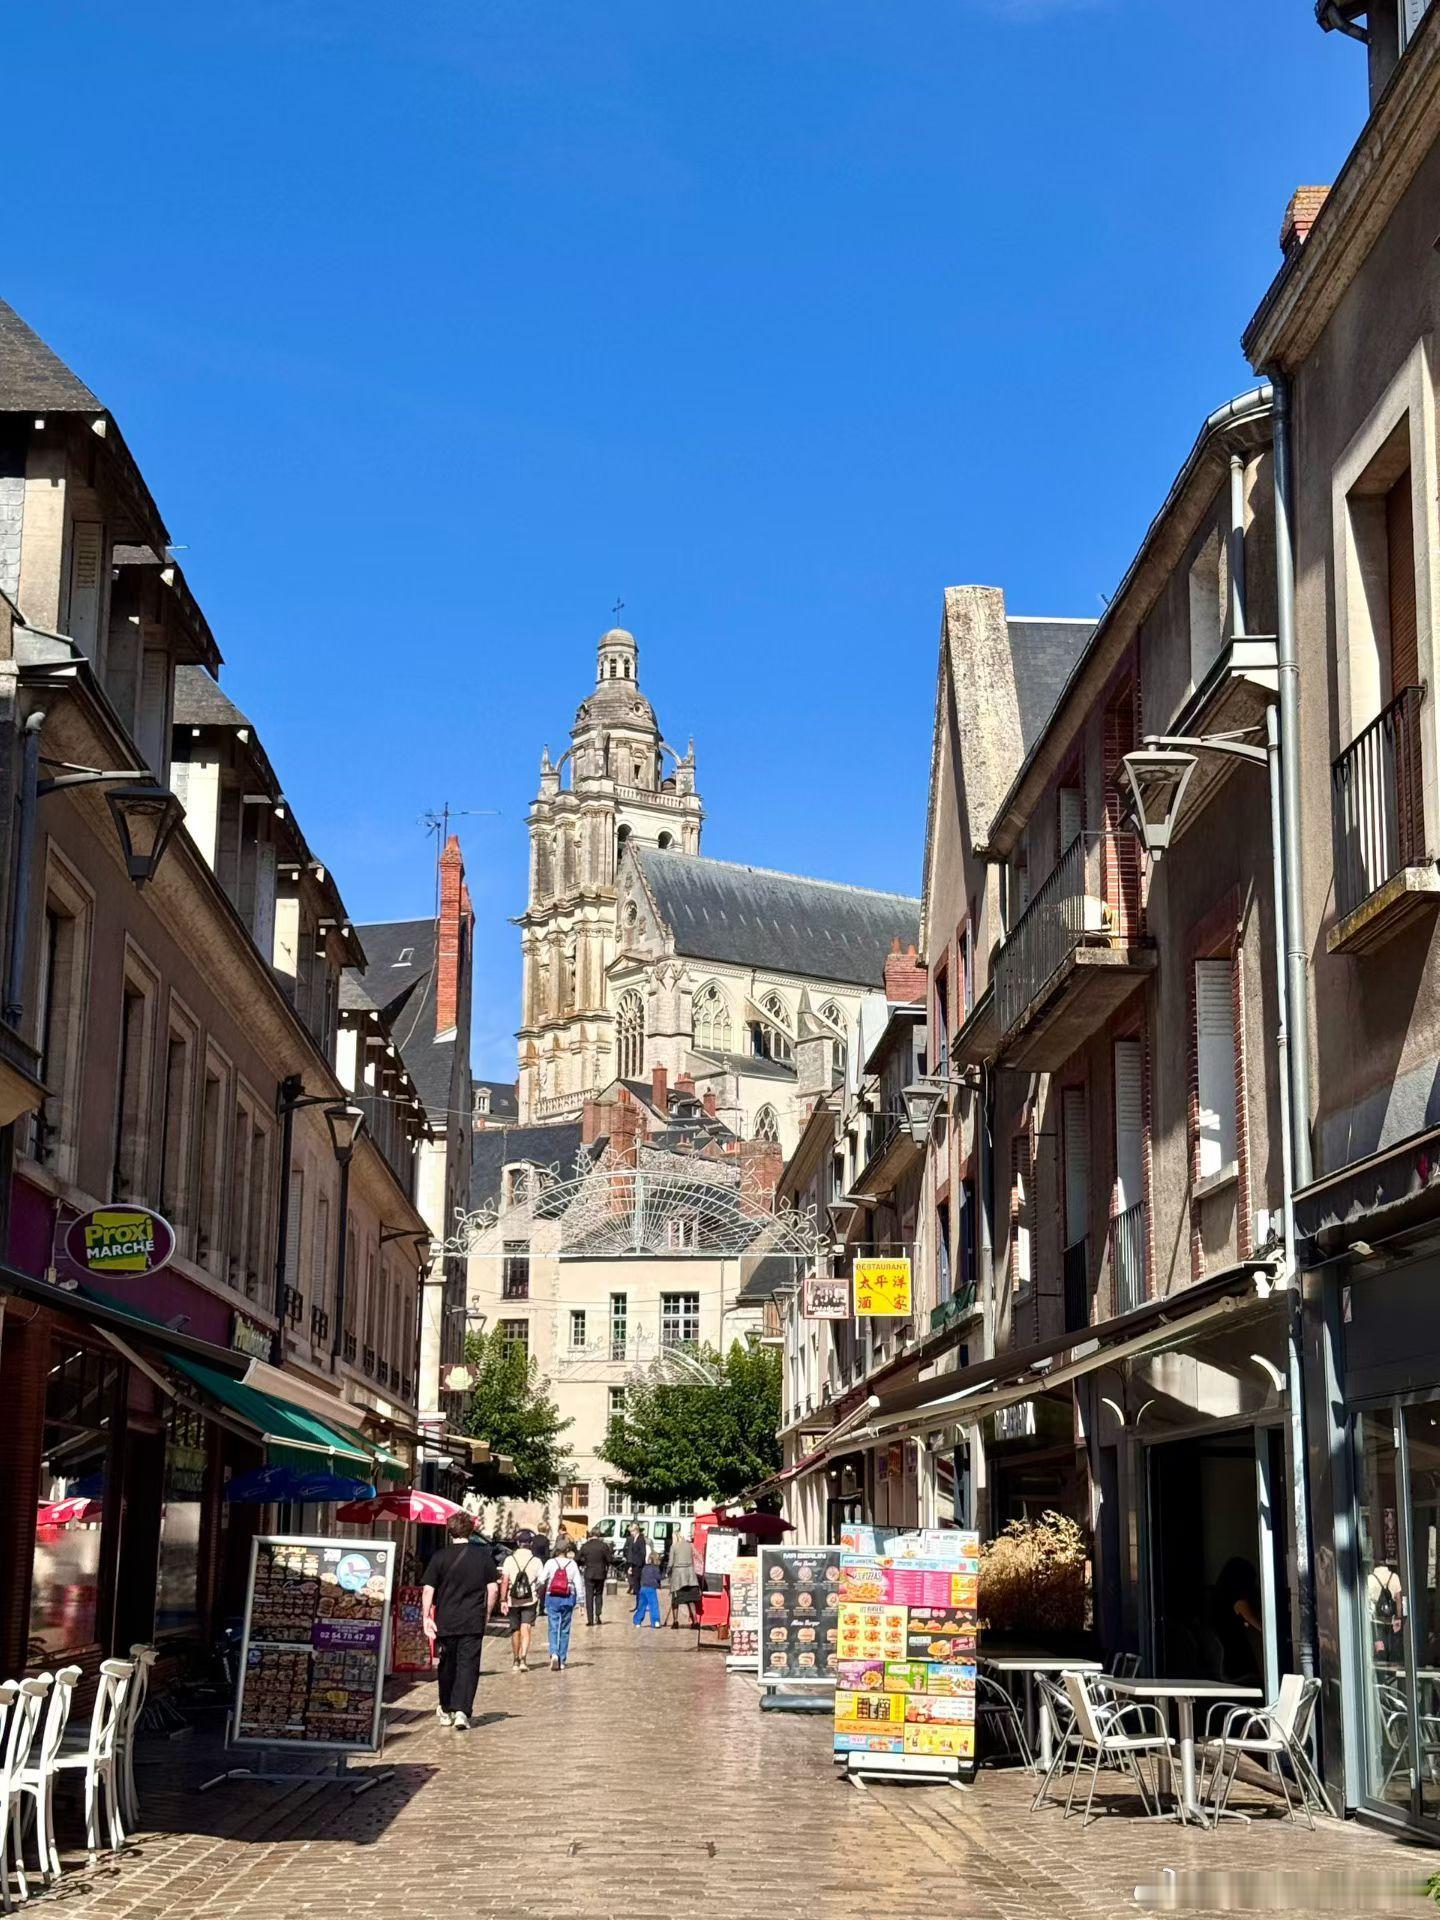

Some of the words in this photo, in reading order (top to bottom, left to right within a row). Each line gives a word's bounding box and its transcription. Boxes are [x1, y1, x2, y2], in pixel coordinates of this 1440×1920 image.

[85, 1218, 154, 1247] Proxi
[86, 1240, 155, 1260] MARCHE
[856, 1263, 908, 1271] RESTAURANT
[858, 1274, 907, 1290] 太平洋
[857, 1293, 909, 1310] 酒家
